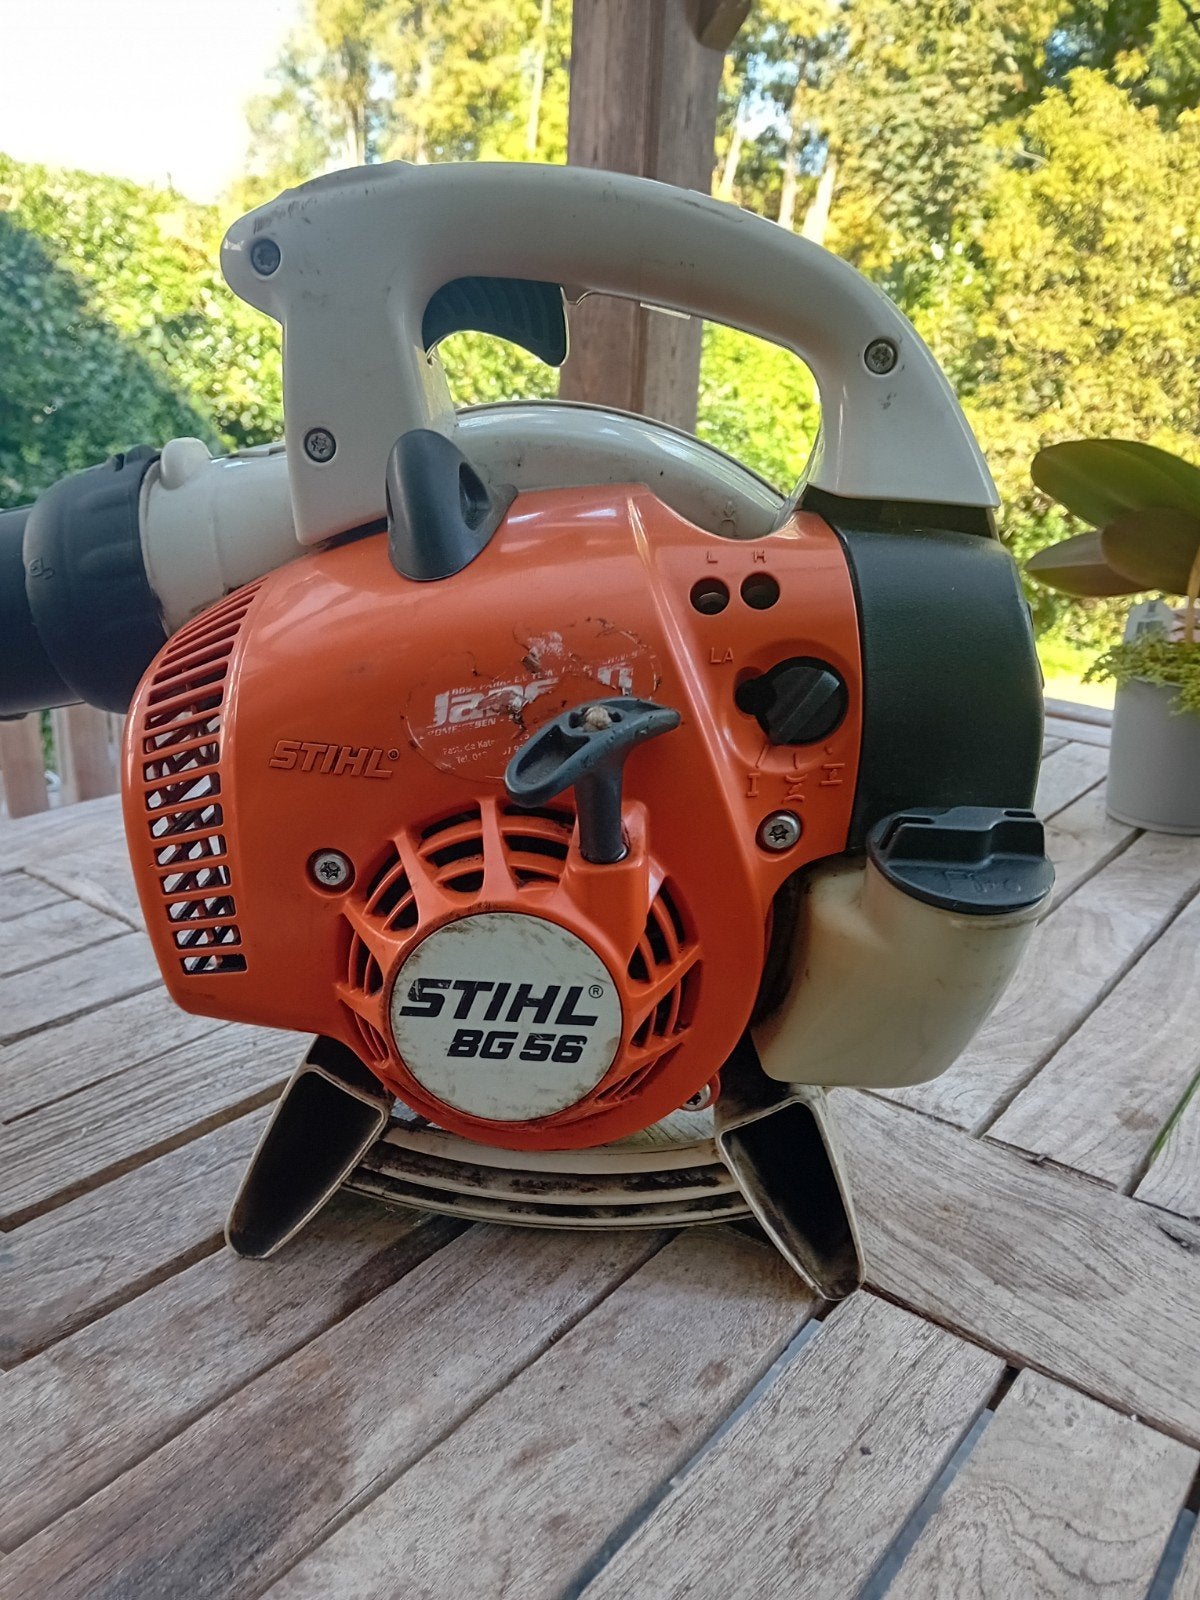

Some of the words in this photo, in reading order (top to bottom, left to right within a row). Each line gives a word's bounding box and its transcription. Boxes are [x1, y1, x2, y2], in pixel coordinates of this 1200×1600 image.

[710, 647, 734, 664] LA
[269, 739, 393, 779] STIHL
[399, 978, 598, 1027] STIHL
[446, 1029, 519, 1060] BG
[519, 1033, 588, 1063] 56
